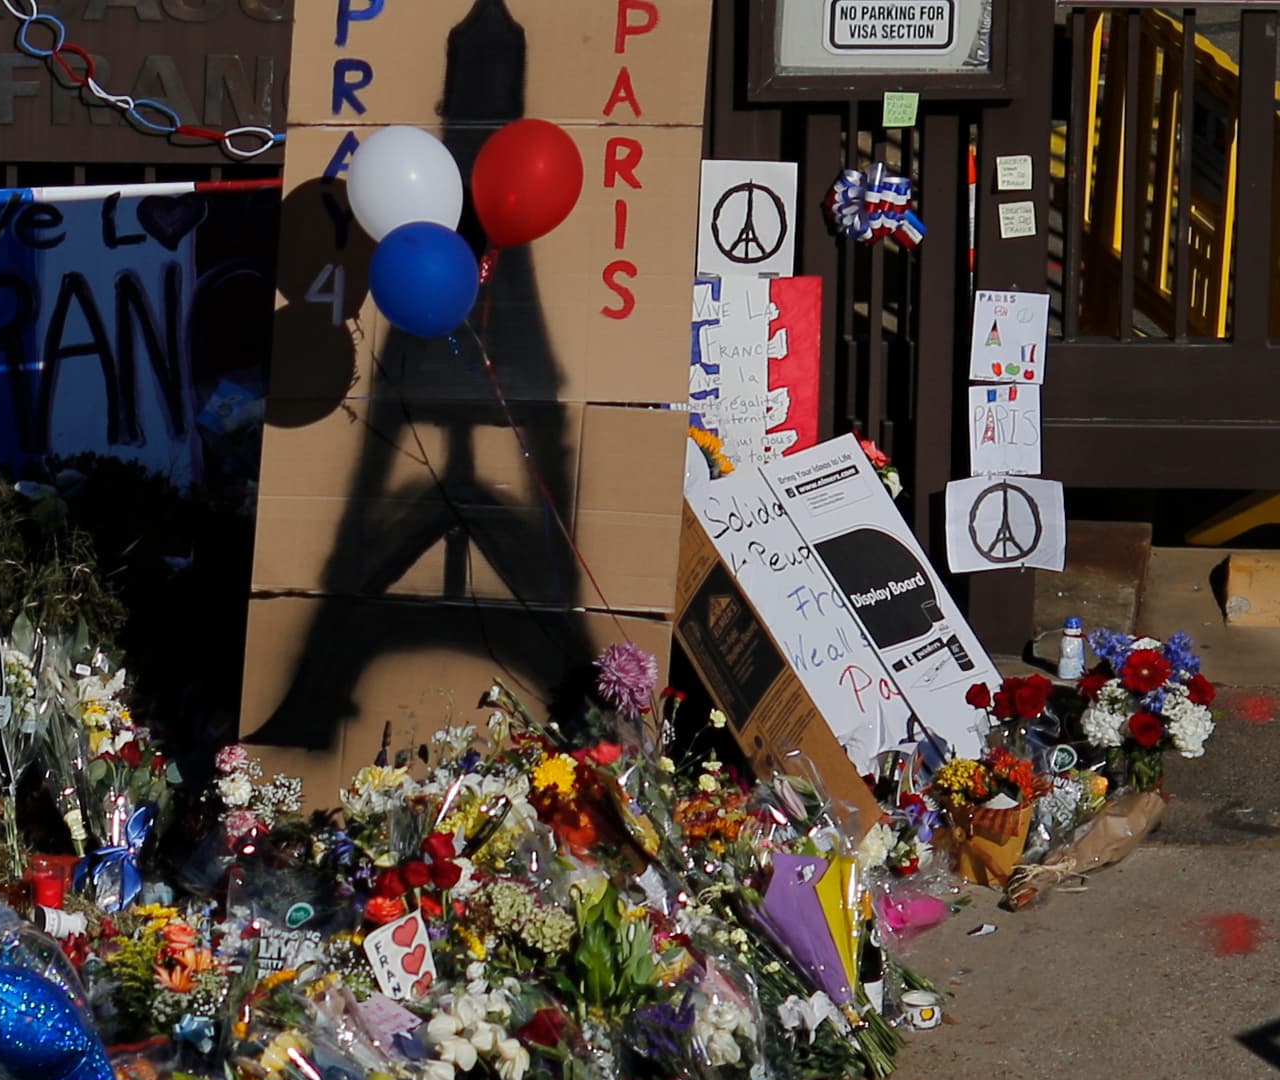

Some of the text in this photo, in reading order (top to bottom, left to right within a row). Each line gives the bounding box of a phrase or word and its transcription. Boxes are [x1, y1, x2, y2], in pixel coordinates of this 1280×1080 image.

[840, 6, 944, 21] NO PARKING FOR
[849, 24, 935, 39] VISA SECTION
[599, 0, 660, 320] PARIS
[304, 264, 345, 326] 4
[979, 293, 1016, 303] PARIS
[974, 405, 1039, 448] PARIS
[851, 571, 925, 609] Display Board
